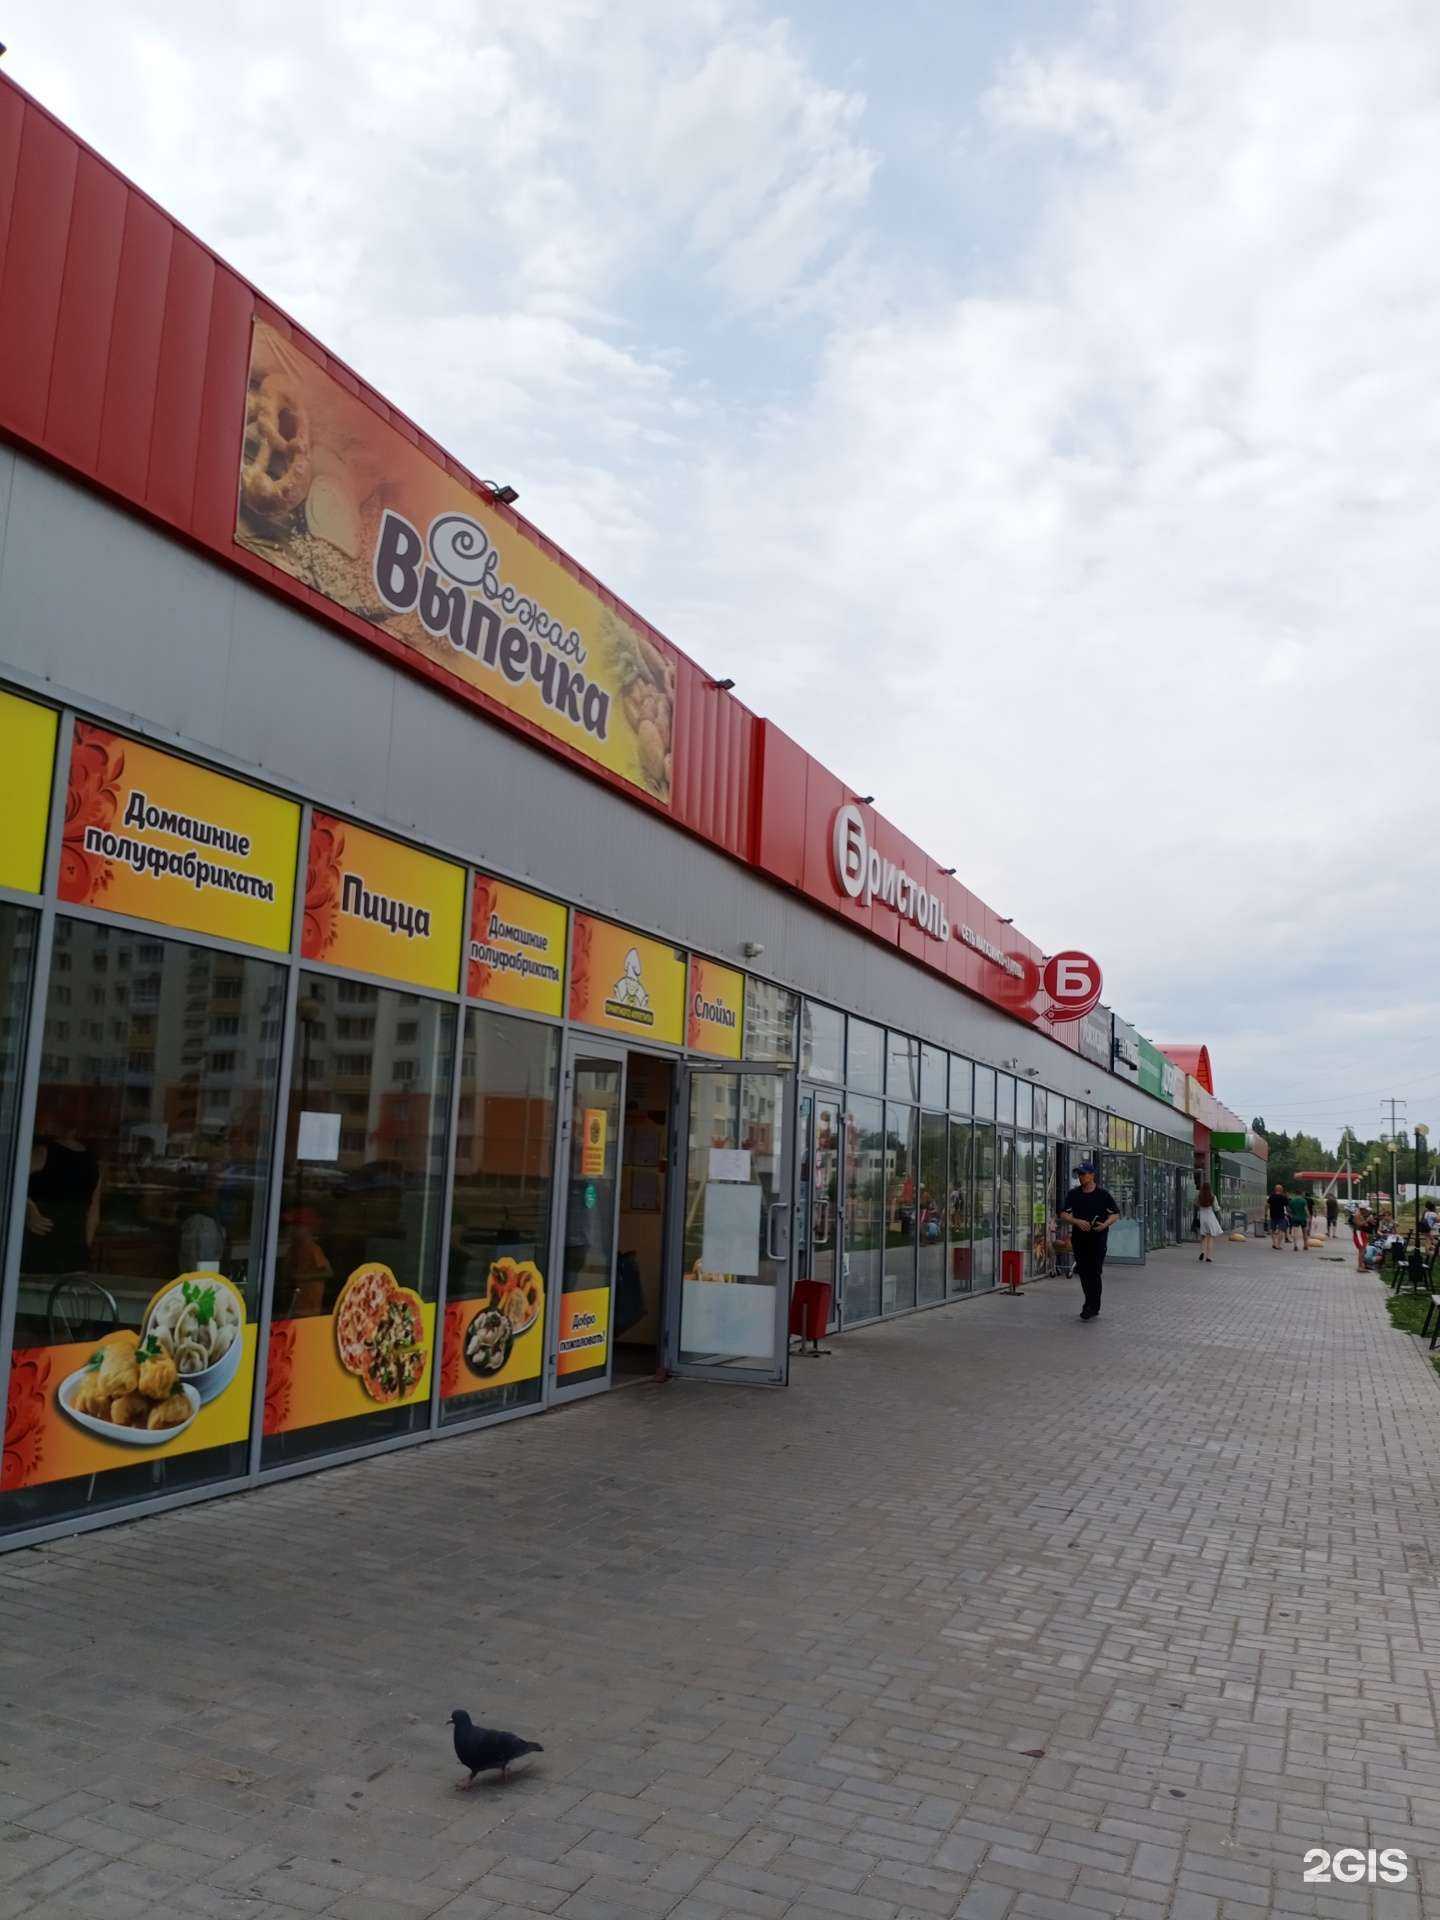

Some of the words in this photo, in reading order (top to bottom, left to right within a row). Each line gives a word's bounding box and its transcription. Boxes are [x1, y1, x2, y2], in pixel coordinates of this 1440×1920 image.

[428, 514, 588, 665] Свежая
[376, 512, 610, 741] Выпечка
[124, 790, 251, 857] Домашние
[84, 828, 275, 903] полуфабрикаты
[832, 804, 949, 943] Бристоль
[341, 873, 432, 938] Пицца
[488, 913, 549, 951] Домашние
[470, 943, 560, 982] полуфабрикаты
[1056, 959, 1092, 997] Б
[694, 993, 736, 1028] Слойки
